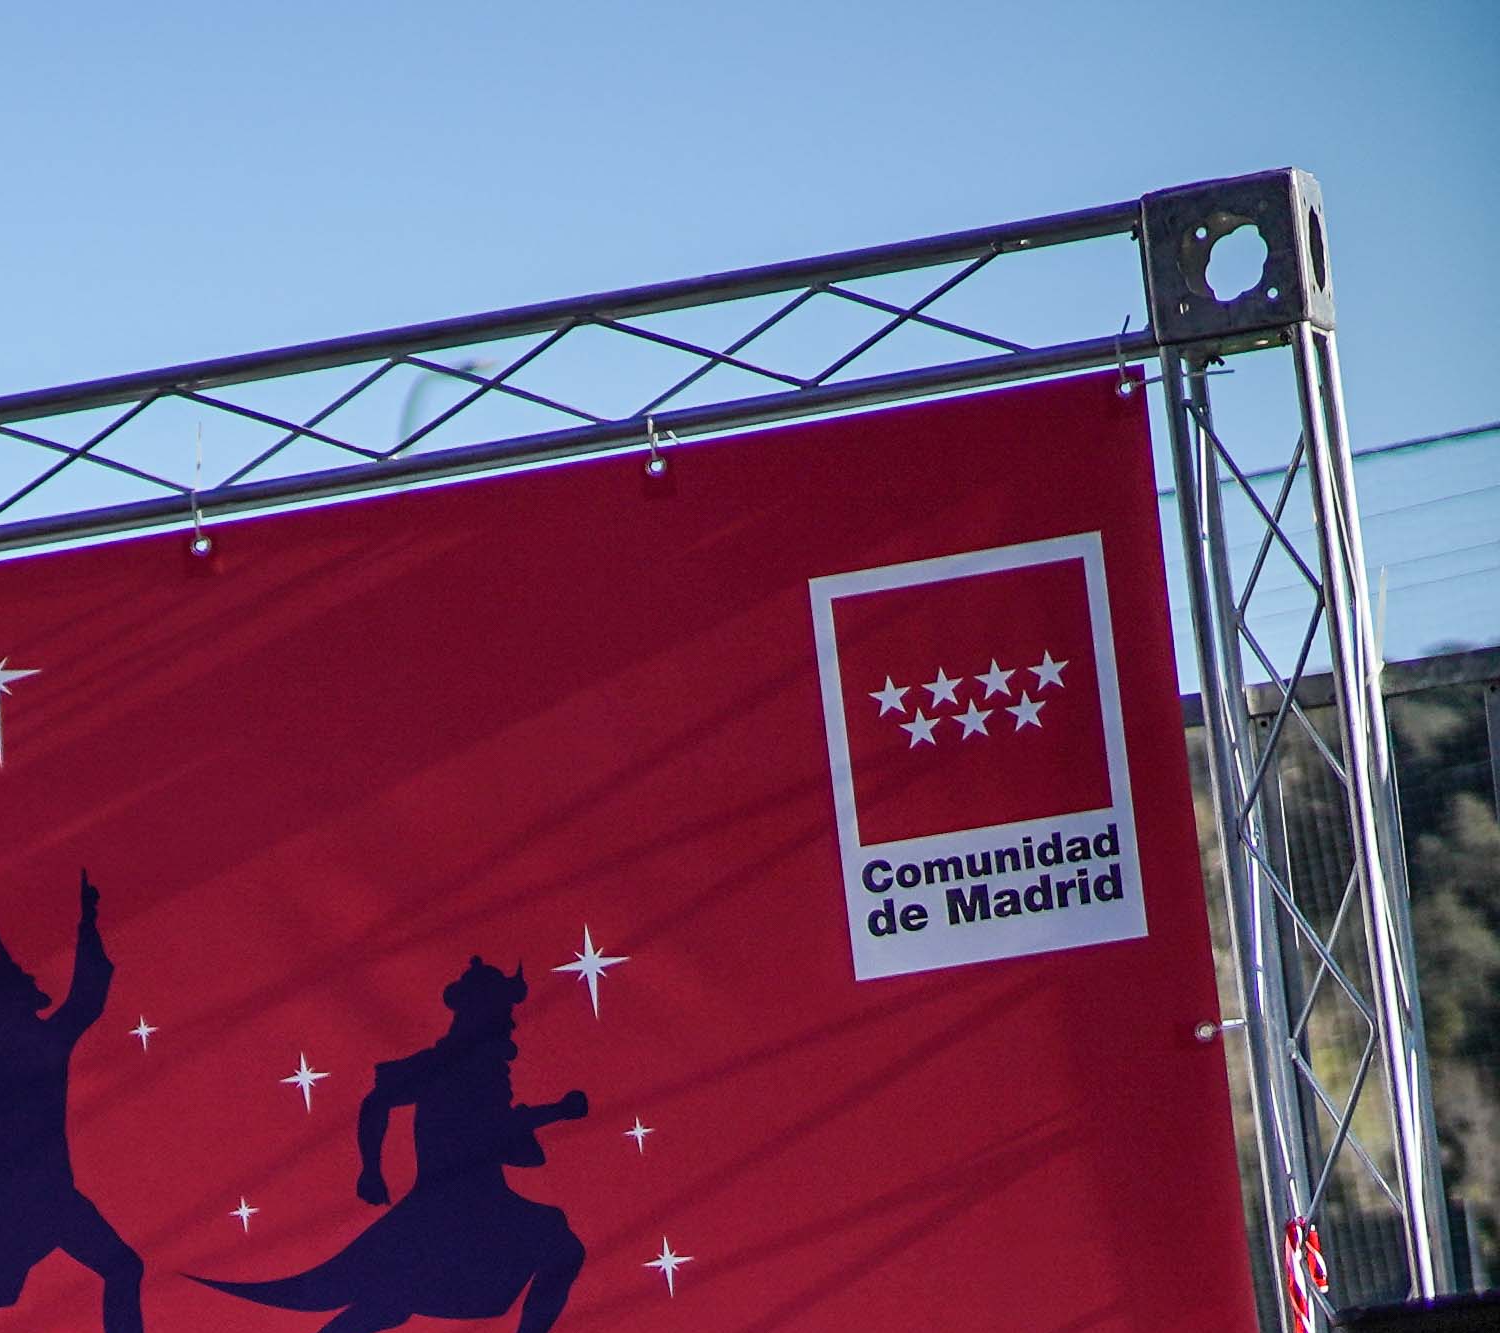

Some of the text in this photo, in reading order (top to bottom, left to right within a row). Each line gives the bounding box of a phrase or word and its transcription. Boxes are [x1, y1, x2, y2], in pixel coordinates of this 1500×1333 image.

[861, 824, 1121, 893] Comunidad
[867, 863, 1124, 937] de Madrid
